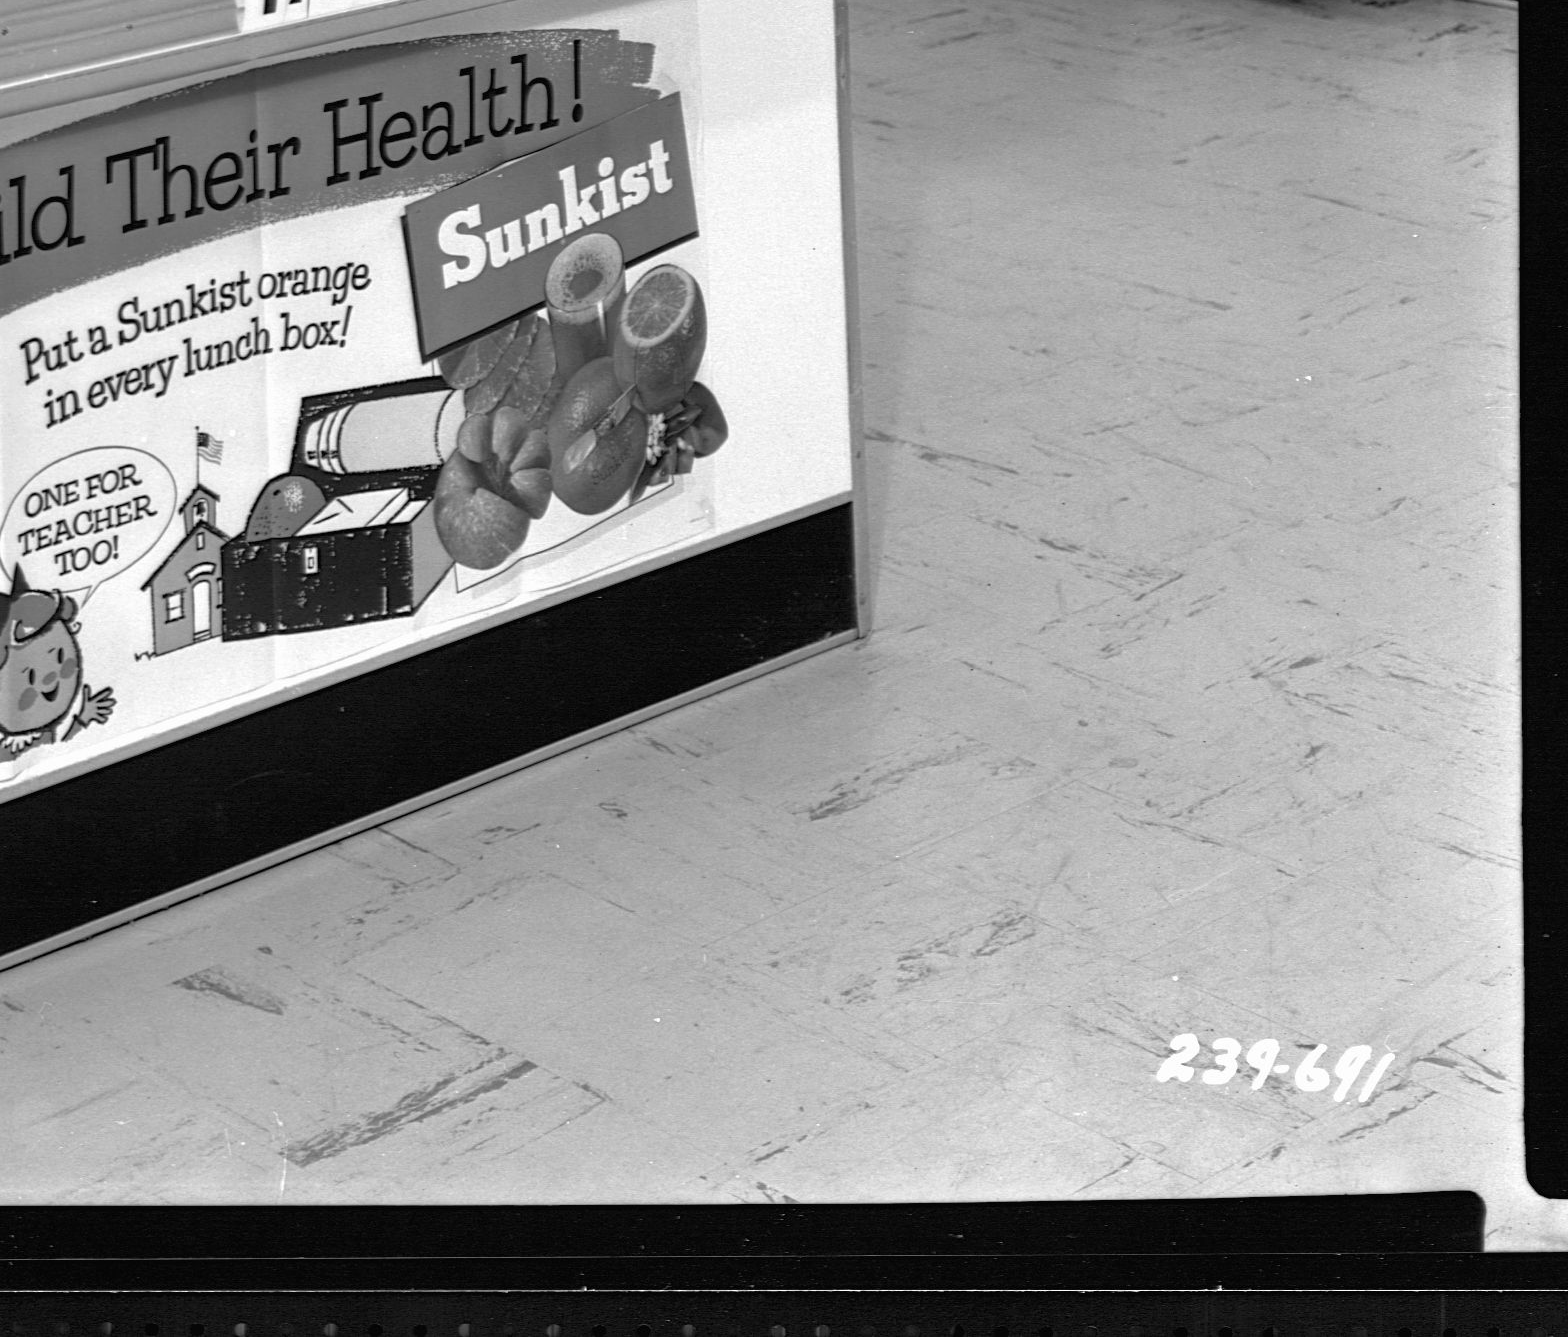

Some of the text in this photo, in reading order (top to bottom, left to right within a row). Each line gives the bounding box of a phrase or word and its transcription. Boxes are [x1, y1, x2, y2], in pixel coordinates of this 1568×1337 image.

[104, 127, 301, 234] Their
[322, 38, 586, 185] Health!
[437, 139, 675, 290] Sunkist
[20, 258, 372, 385] Put a Sunkist orange
[43, 306, 353, 428] in every lunch box!
[16, 494, 159, 556] TEACHER
[23, 463, 143, 517] ONE FOR
[53, 532, 120, 578] TOO!
